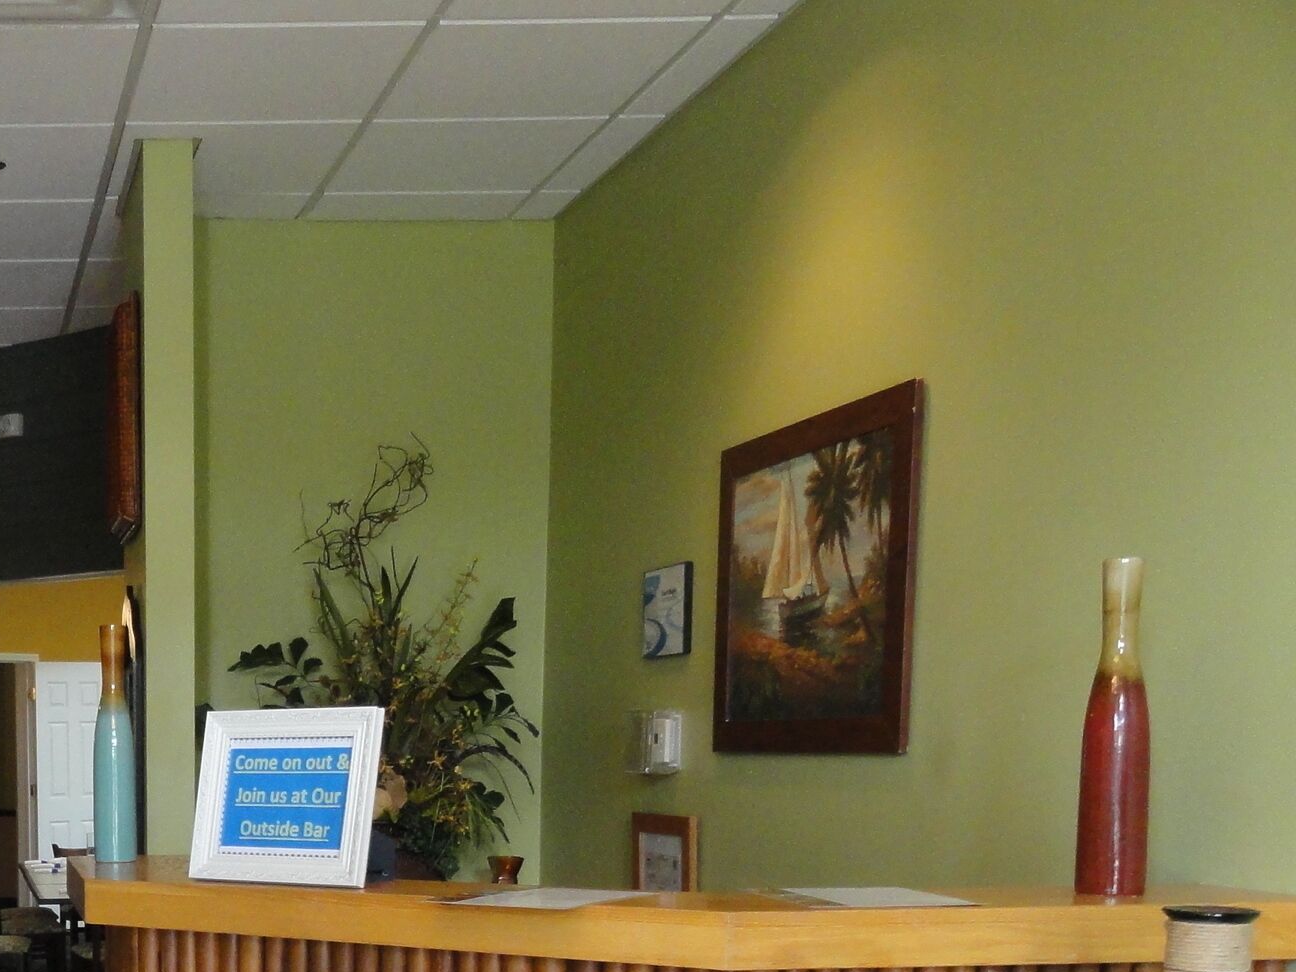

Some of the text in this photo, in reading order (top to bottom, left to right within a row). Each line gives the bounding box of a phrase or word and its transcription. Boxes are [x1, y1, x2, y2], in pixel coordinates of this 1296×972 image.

[235, 753, 349, 771] Come on out &
[235, 787, 342, 804] Join us at Our
[240, 820, 331, 839] Outside Bar
